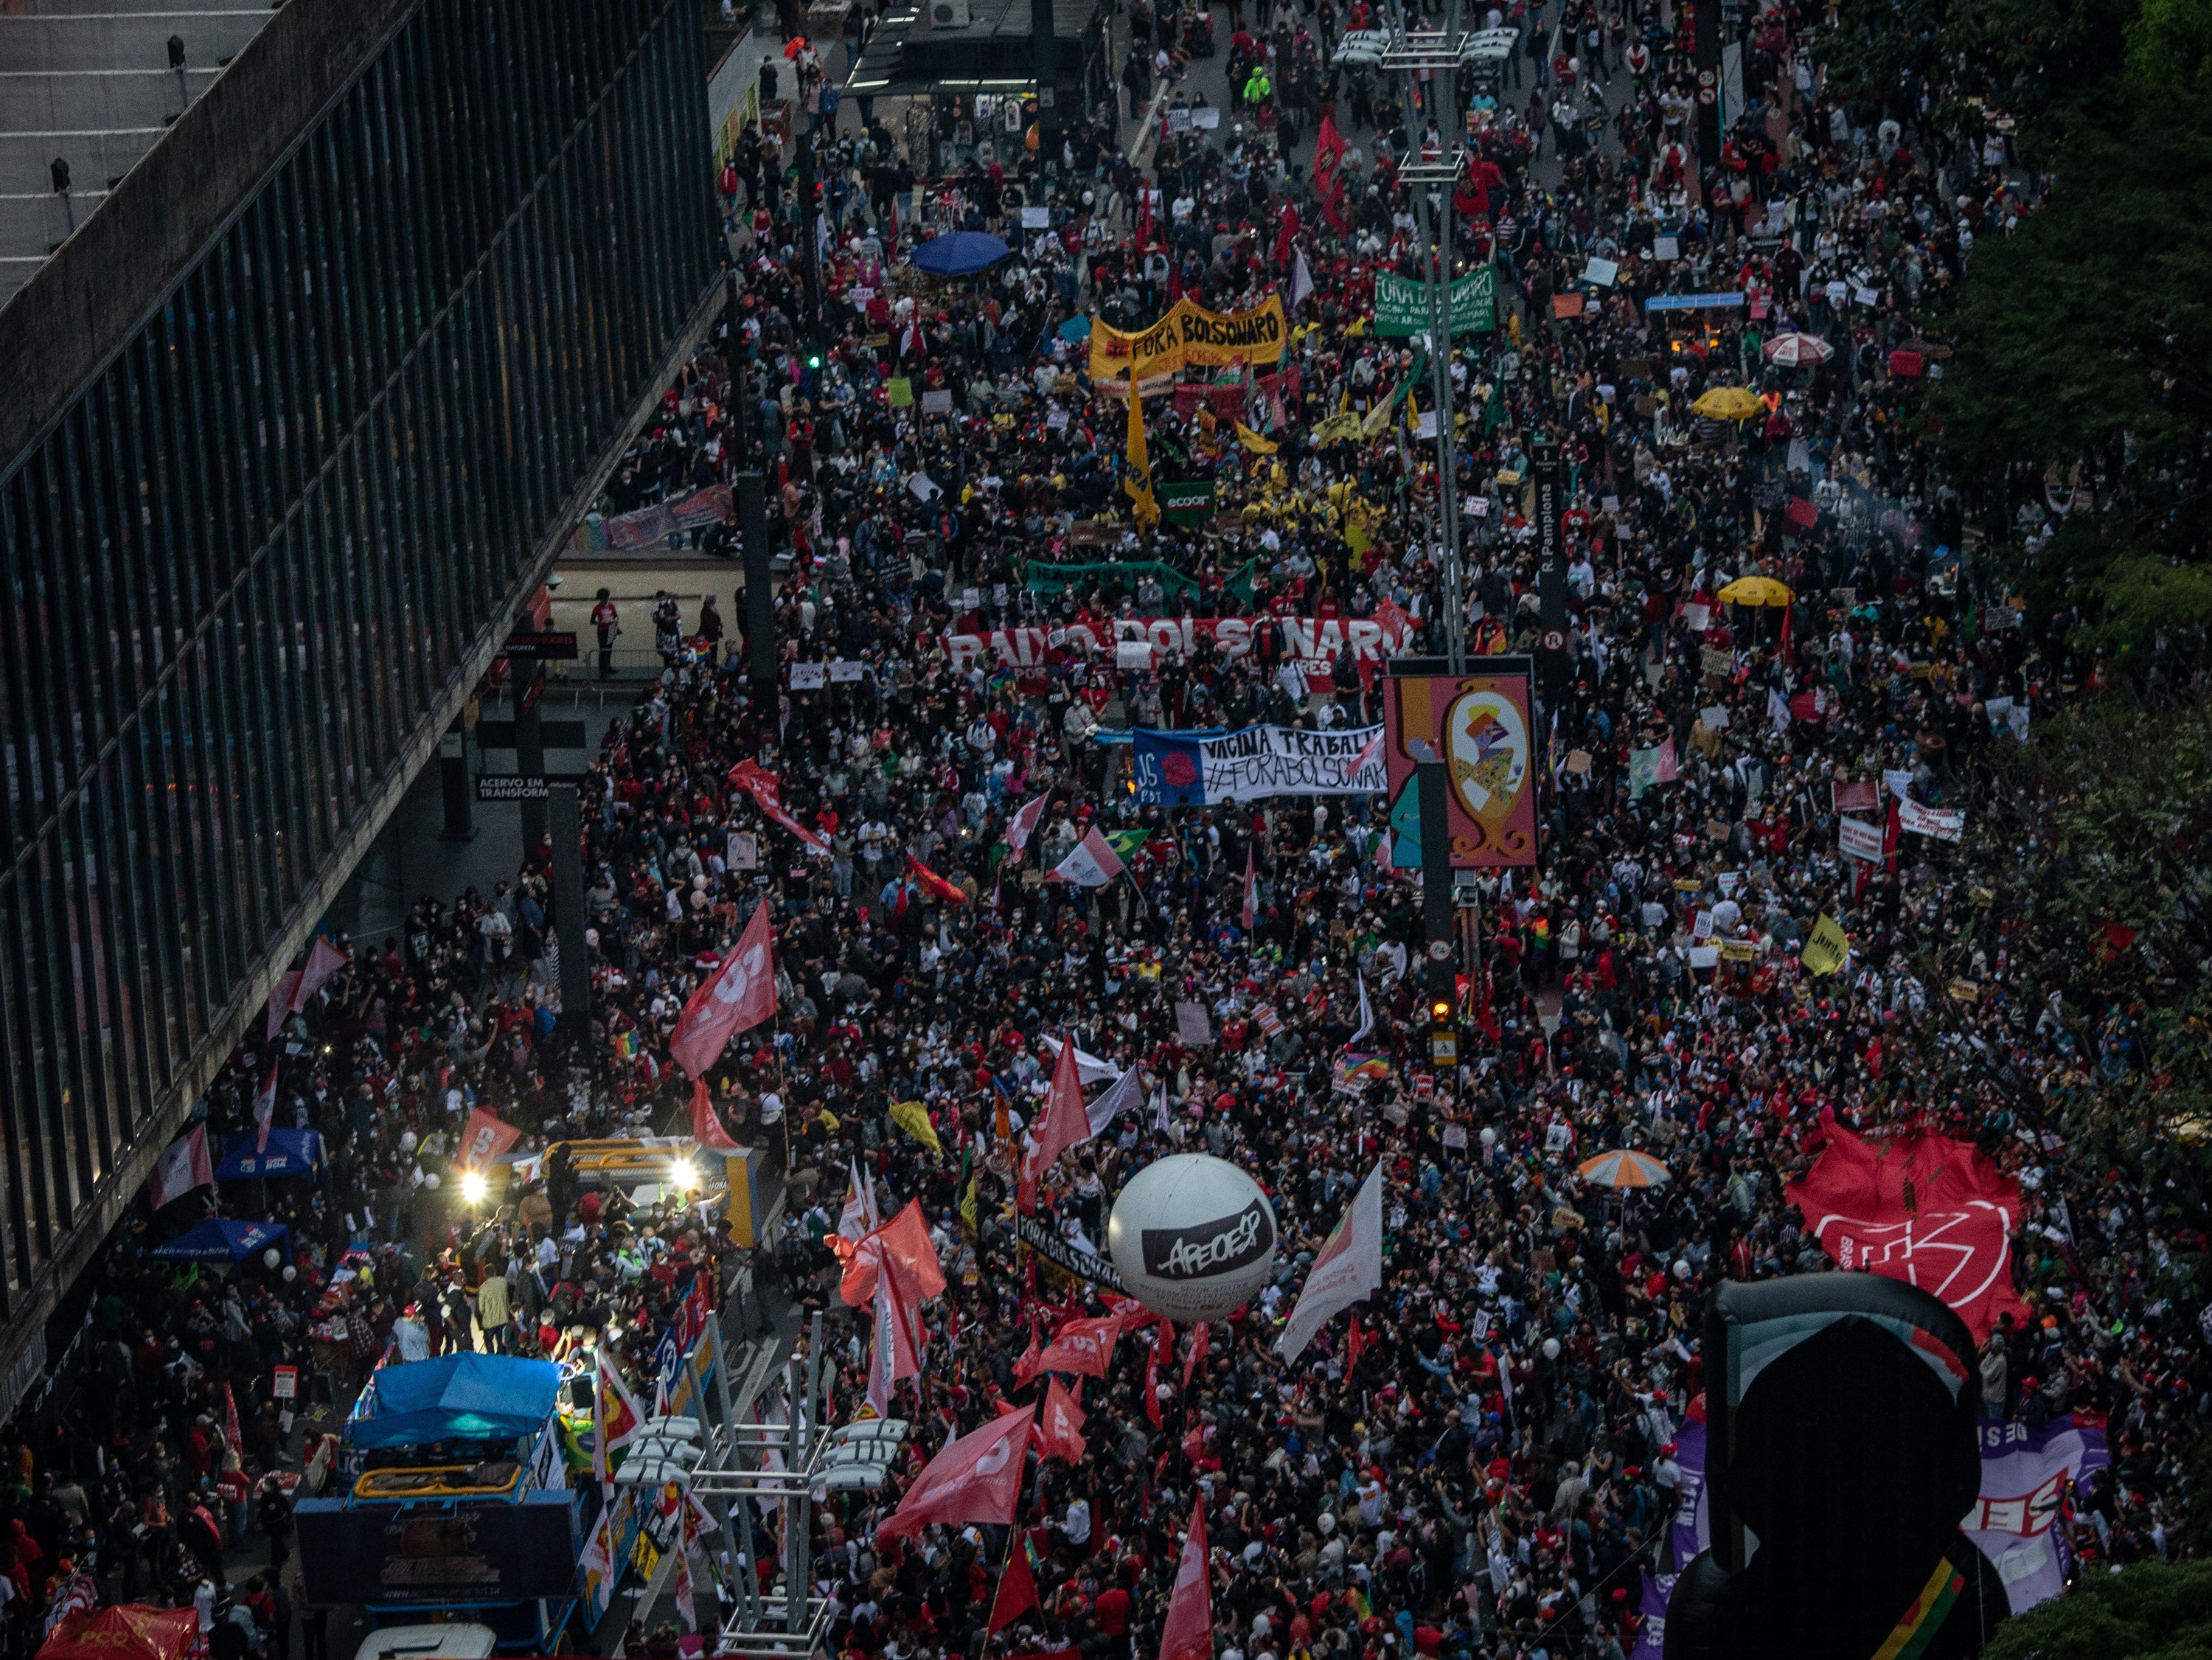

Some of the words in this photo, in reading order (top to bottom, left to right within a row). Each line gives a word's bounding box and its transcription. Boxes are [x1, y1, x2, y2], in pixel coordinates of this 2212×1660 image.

[1375, 274, 1413, 305] FORA
[1133, 323, 1178, 361] FORA
[1181, 311, 1279, 347] BOLSONARO
[1167, 494, 1210, 508] ecoar
[1542, 483, 1555, 555] Pamplona
[1542, 562, 1554, 572] R.
[1113, 616, 1414, 661] BOLSNAR
[1015, 666, 1048, 683] POR
[480, 777, 524, 788] ACERVO
[526, 778, 545, 788] EM
[480, 788, 549, 798] TRANSFORM
[1020, 1215, 1048, 1254] FORA
[1157, 1209, 1261, 1275] APEOESP
